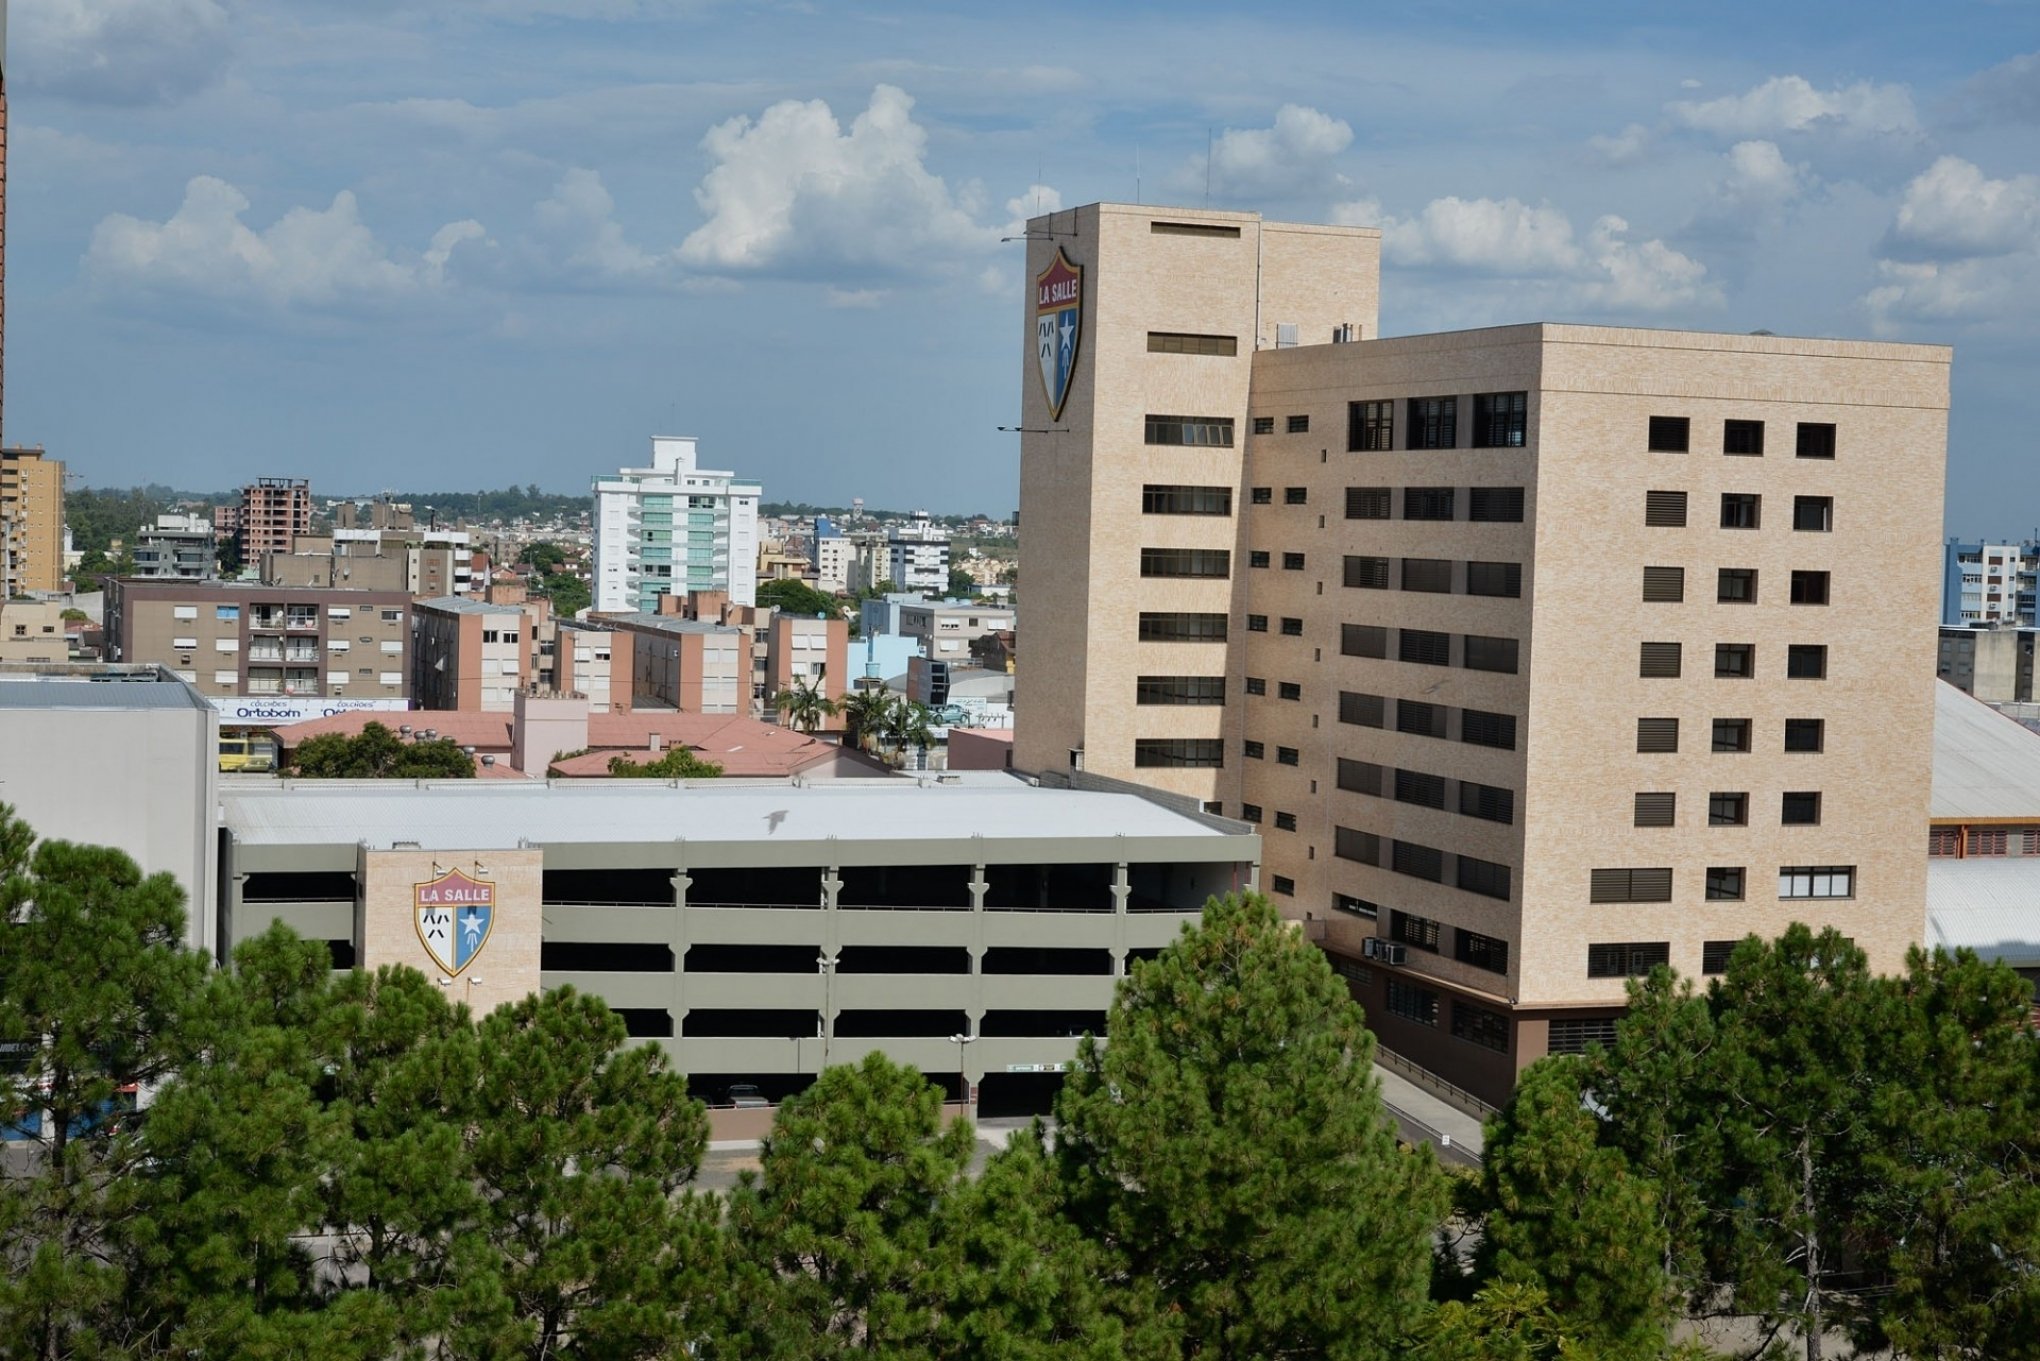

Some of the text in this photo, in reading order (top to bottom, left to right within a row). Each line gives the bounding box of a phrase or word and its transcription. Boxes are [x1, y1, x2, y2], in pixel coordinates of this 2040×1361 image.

[1039, 279, 1077, 305] LA SALLE
[237, 707, 301, 718] Ortobom
[421, 888, 490, 902] LA SALLE
